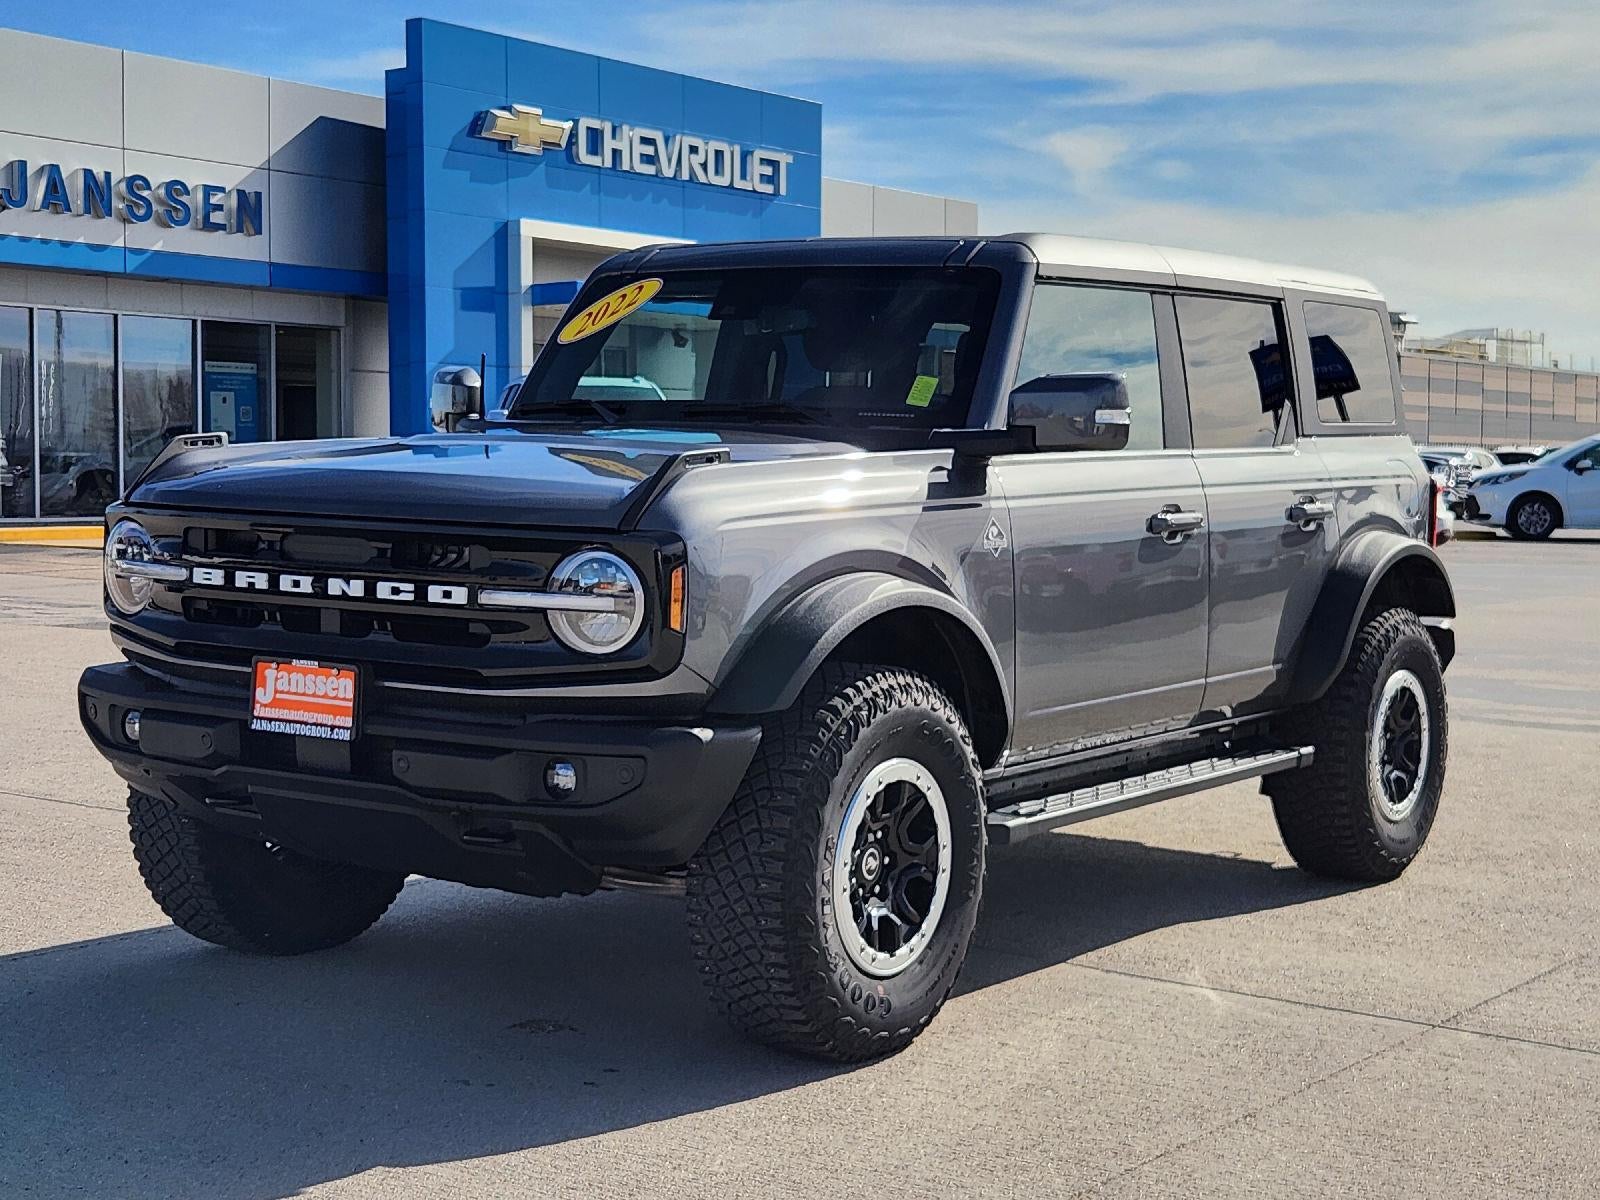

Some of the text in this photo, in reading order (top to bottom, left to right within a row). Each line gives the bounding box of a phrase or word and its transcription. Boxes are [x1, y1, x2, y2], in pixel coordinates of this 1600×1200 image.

[573, 116, 794, 196] CHEVROLET
[0, 159, 263, 236] JANSSEN
[572, 284, 645, 338] 2022
[192, 567, 468, 605] BRONCO
[255, 668, 354, 704] Janssen
